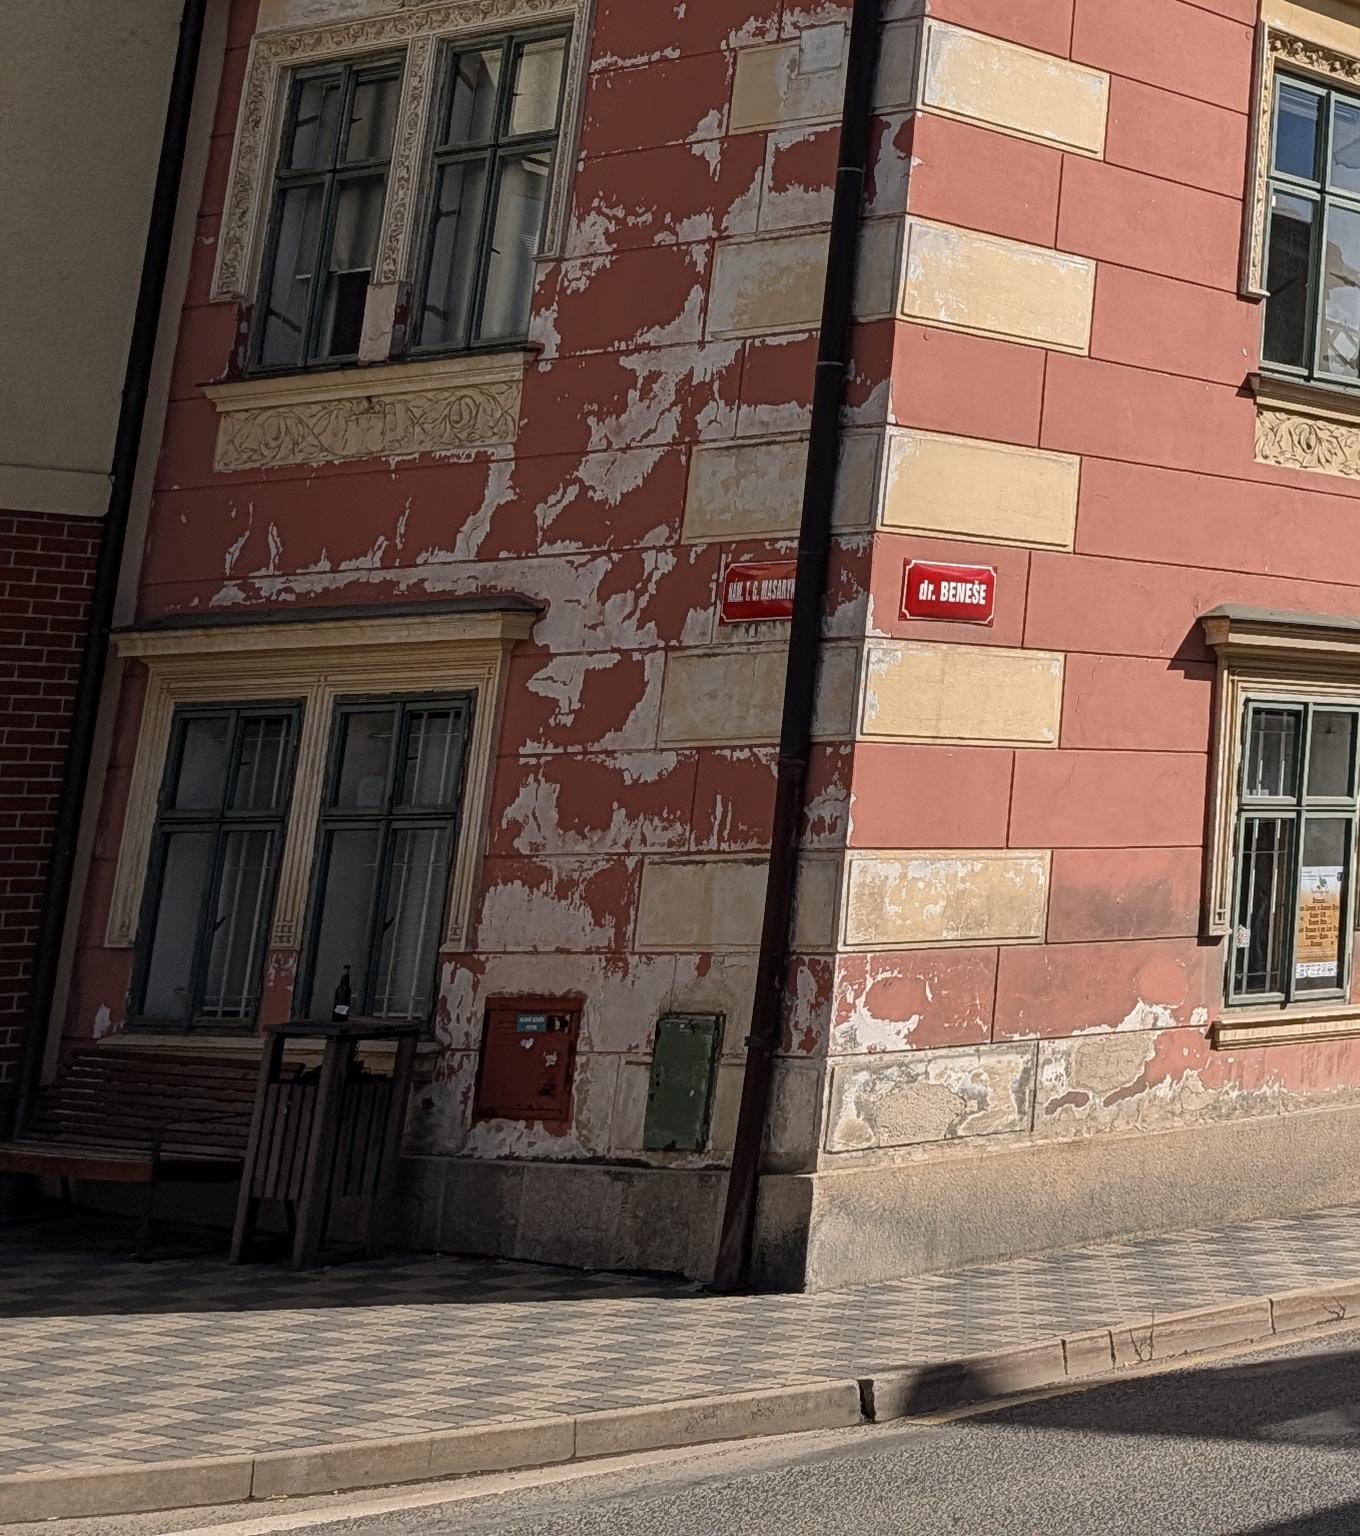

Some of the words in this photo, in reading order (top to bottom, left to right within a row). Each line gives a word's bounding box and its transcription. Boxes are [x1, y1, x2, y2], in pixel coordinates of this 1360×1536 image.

[727, 577, 744, 603] NÁM.
[745, 581, 751, 601] T.
[752, 580, 760, 601] G.
[760, 578, 796, 601] MASARYK
[918, 579, 936, 601] dr.
[940, 579, 987, 605] BENEŠE
